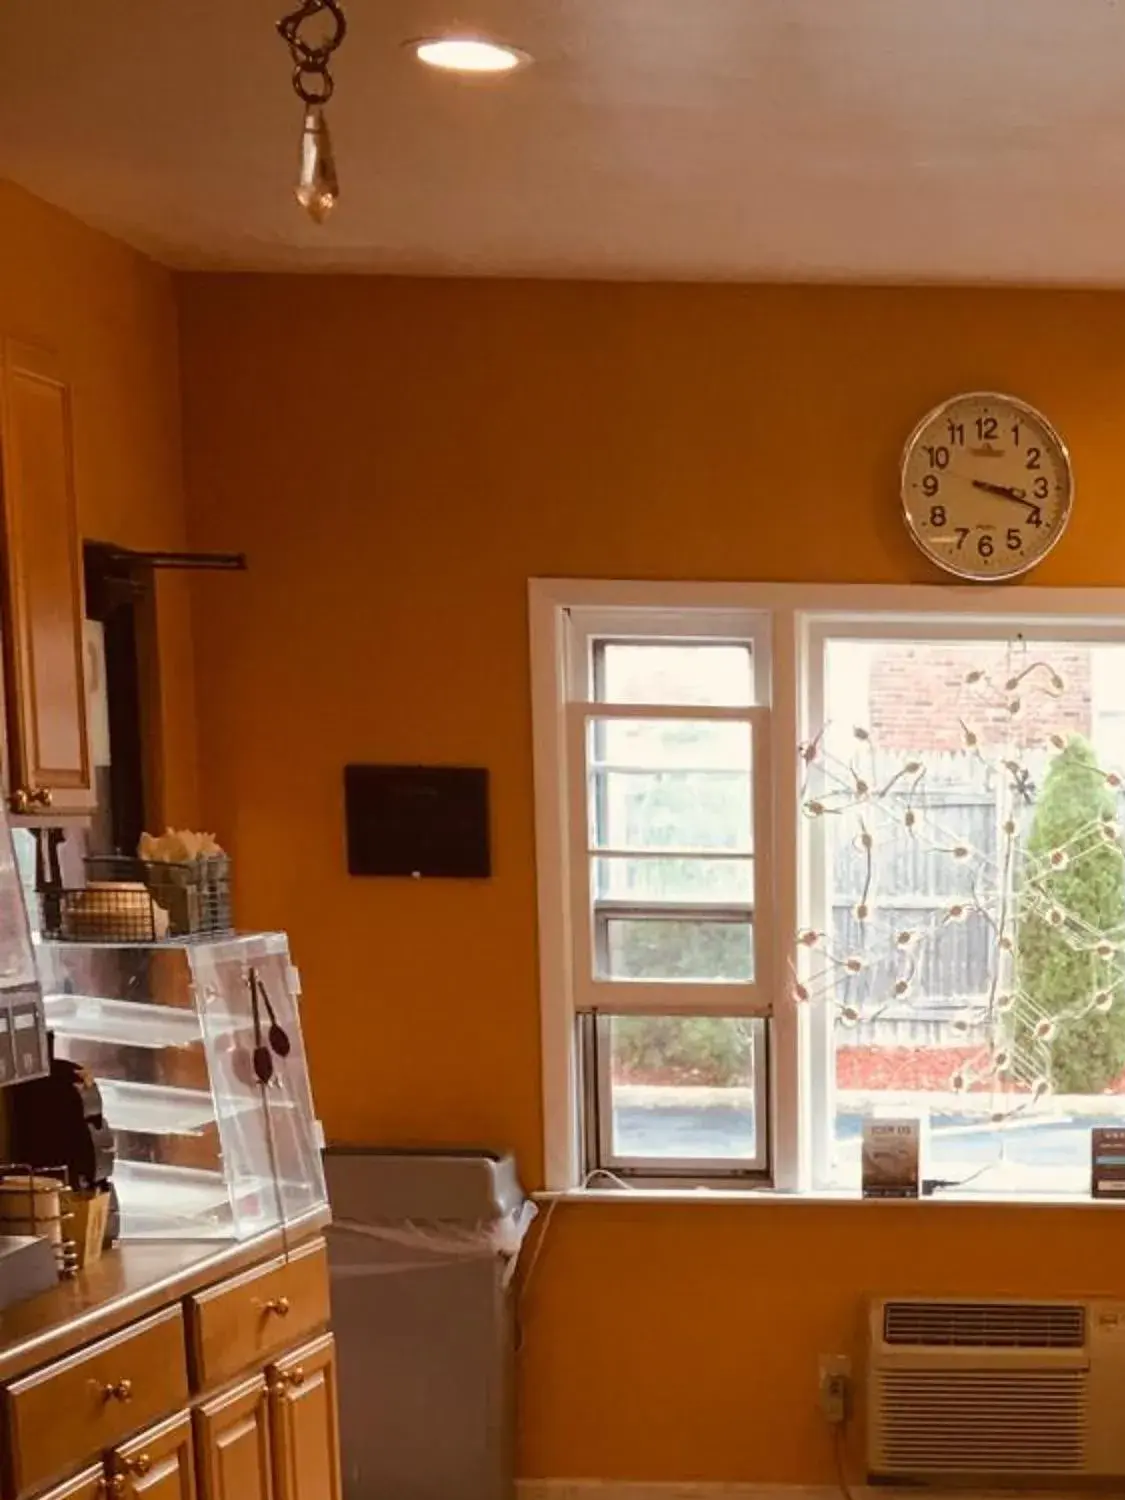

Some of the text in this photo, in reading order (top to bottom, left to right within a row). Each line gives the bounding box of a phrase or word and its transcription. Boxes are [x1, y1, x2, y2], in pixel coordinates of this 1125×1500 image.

[948, 424, 964, 446] 11
[975, 418, 998, 440] 12
[1011, 425, 1019, 446] 1
[928, 447, 949, 469] 10
[1025, 448, 1040, 469] 2
[922, 475, 938, 497] 9
[1034, 477, 1048, 499] 3
[930, 506, 946, 527] 8
[1025, 507, 1042, 528] 4
[954, 528, 970, 549] 7
[978, 535, 994, 557] 6
[1006, 529, 1022, 550] 5
